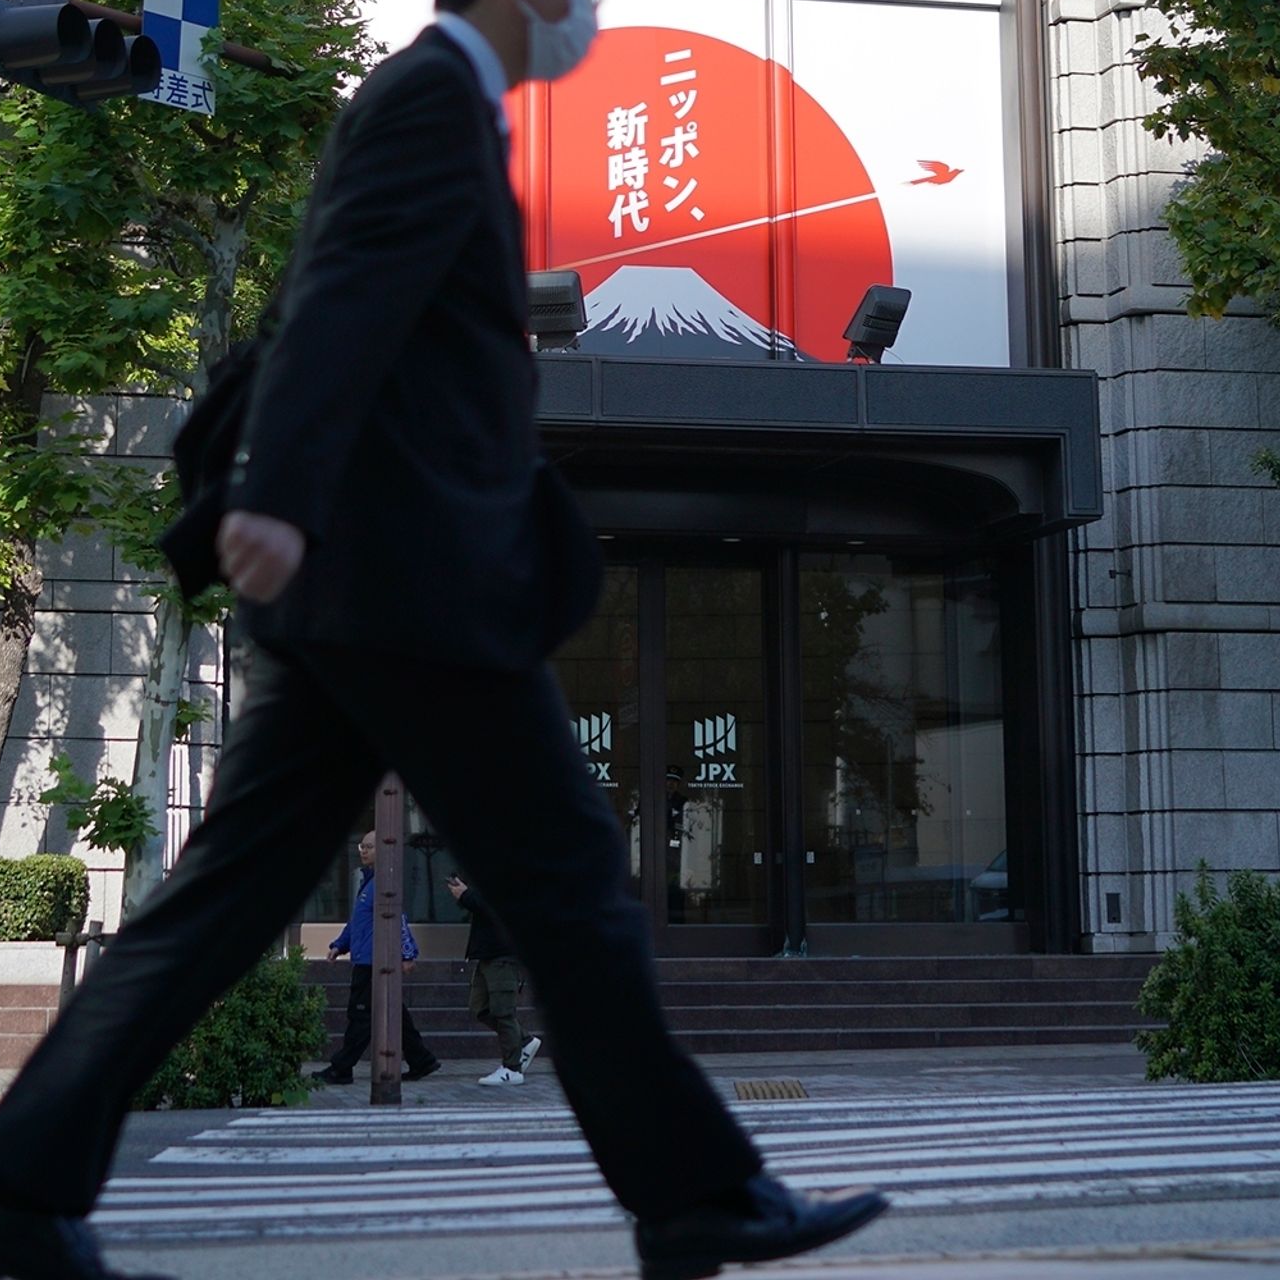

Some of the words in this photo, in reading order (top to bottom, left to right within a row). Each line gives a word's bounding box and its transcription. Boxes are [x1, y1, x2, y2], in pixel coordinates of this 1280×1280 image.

[154, 73, 214, 113] 差式
[607, 102, 650, 239] 新時代
[586, 762, 611, 780] PX
[695, 763, 736, 781] JPX
